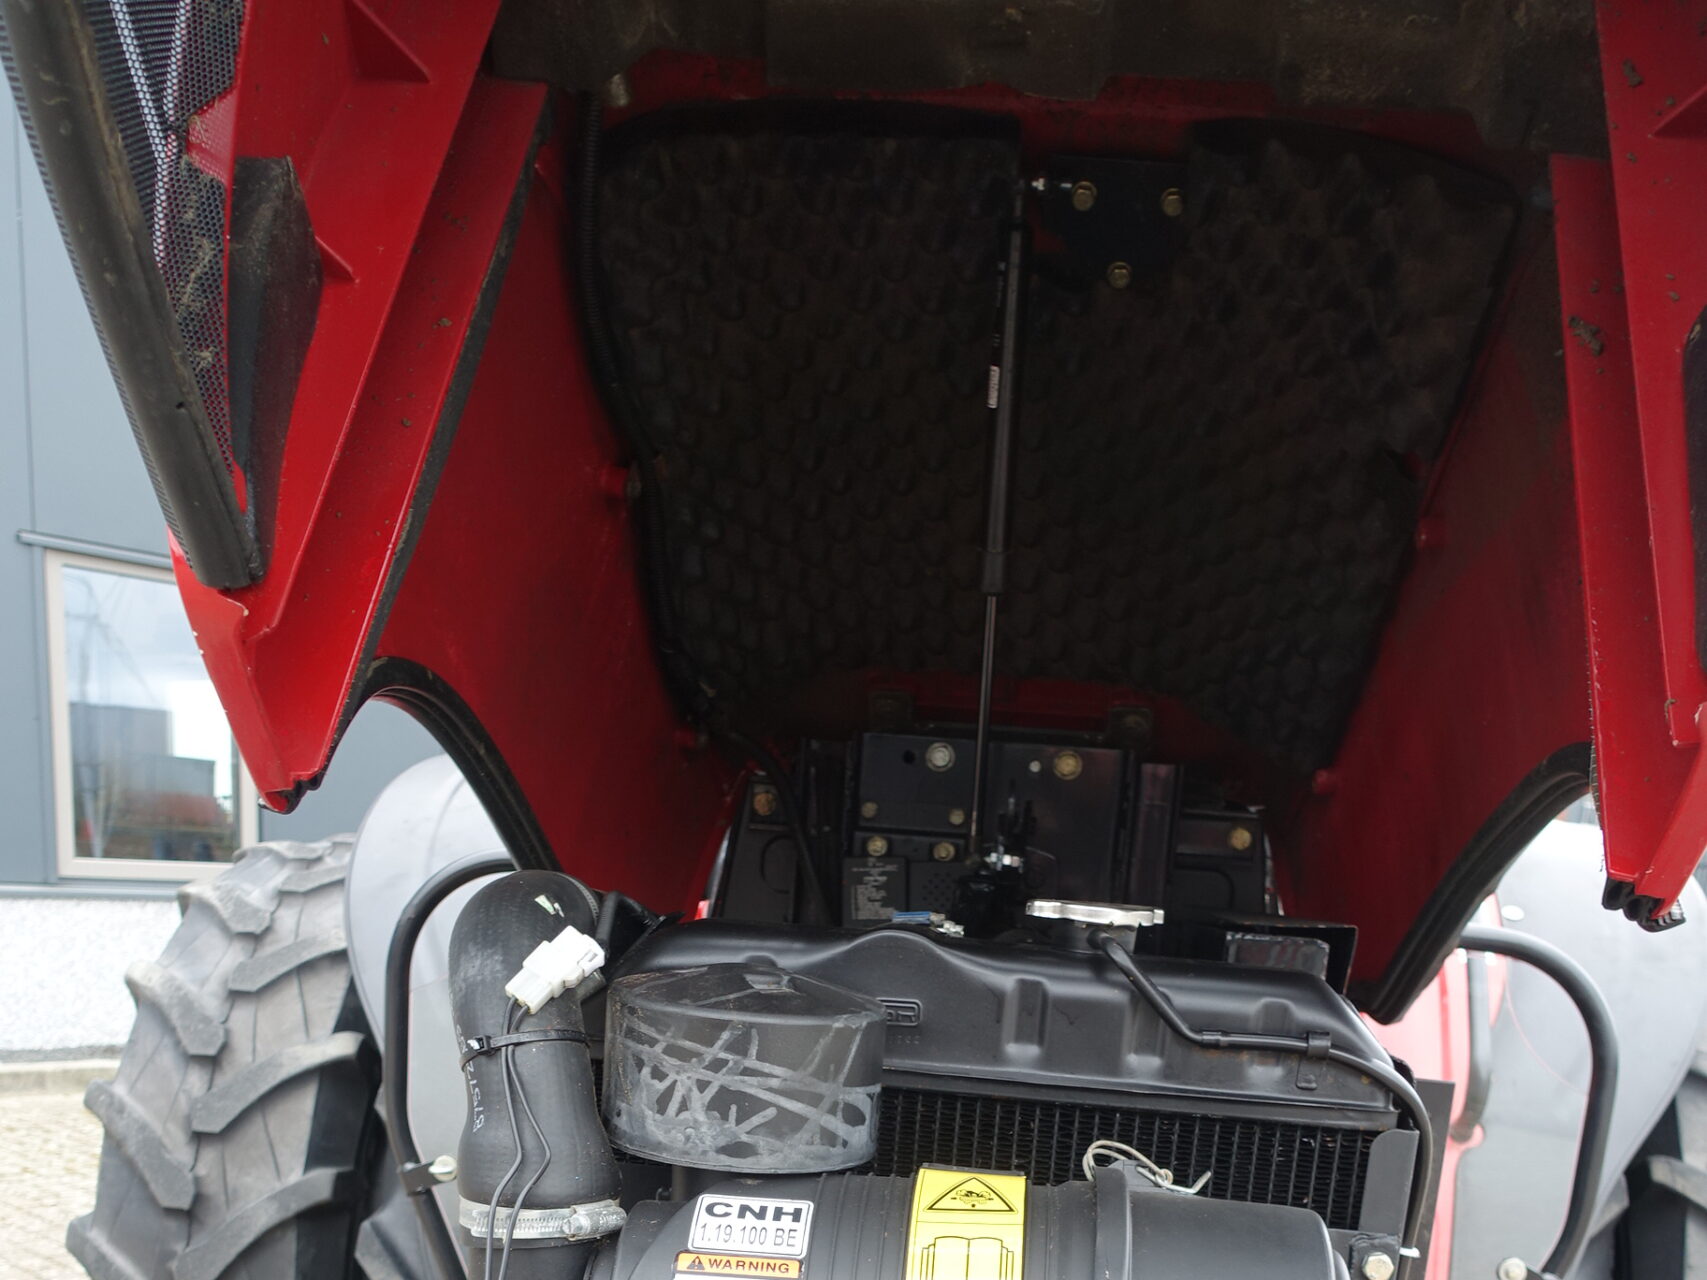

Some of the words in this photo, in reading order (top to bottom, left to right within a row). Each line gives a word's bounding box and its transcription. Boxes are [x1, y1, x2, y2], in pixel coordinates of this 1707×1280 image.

[705, 1202, 803, 1223] CNH
[700, 1223, 768, 1246] 1.19.100
[774, 1227, 798, 1247] BE
[708, 1258, 790, 1274] WARNING
